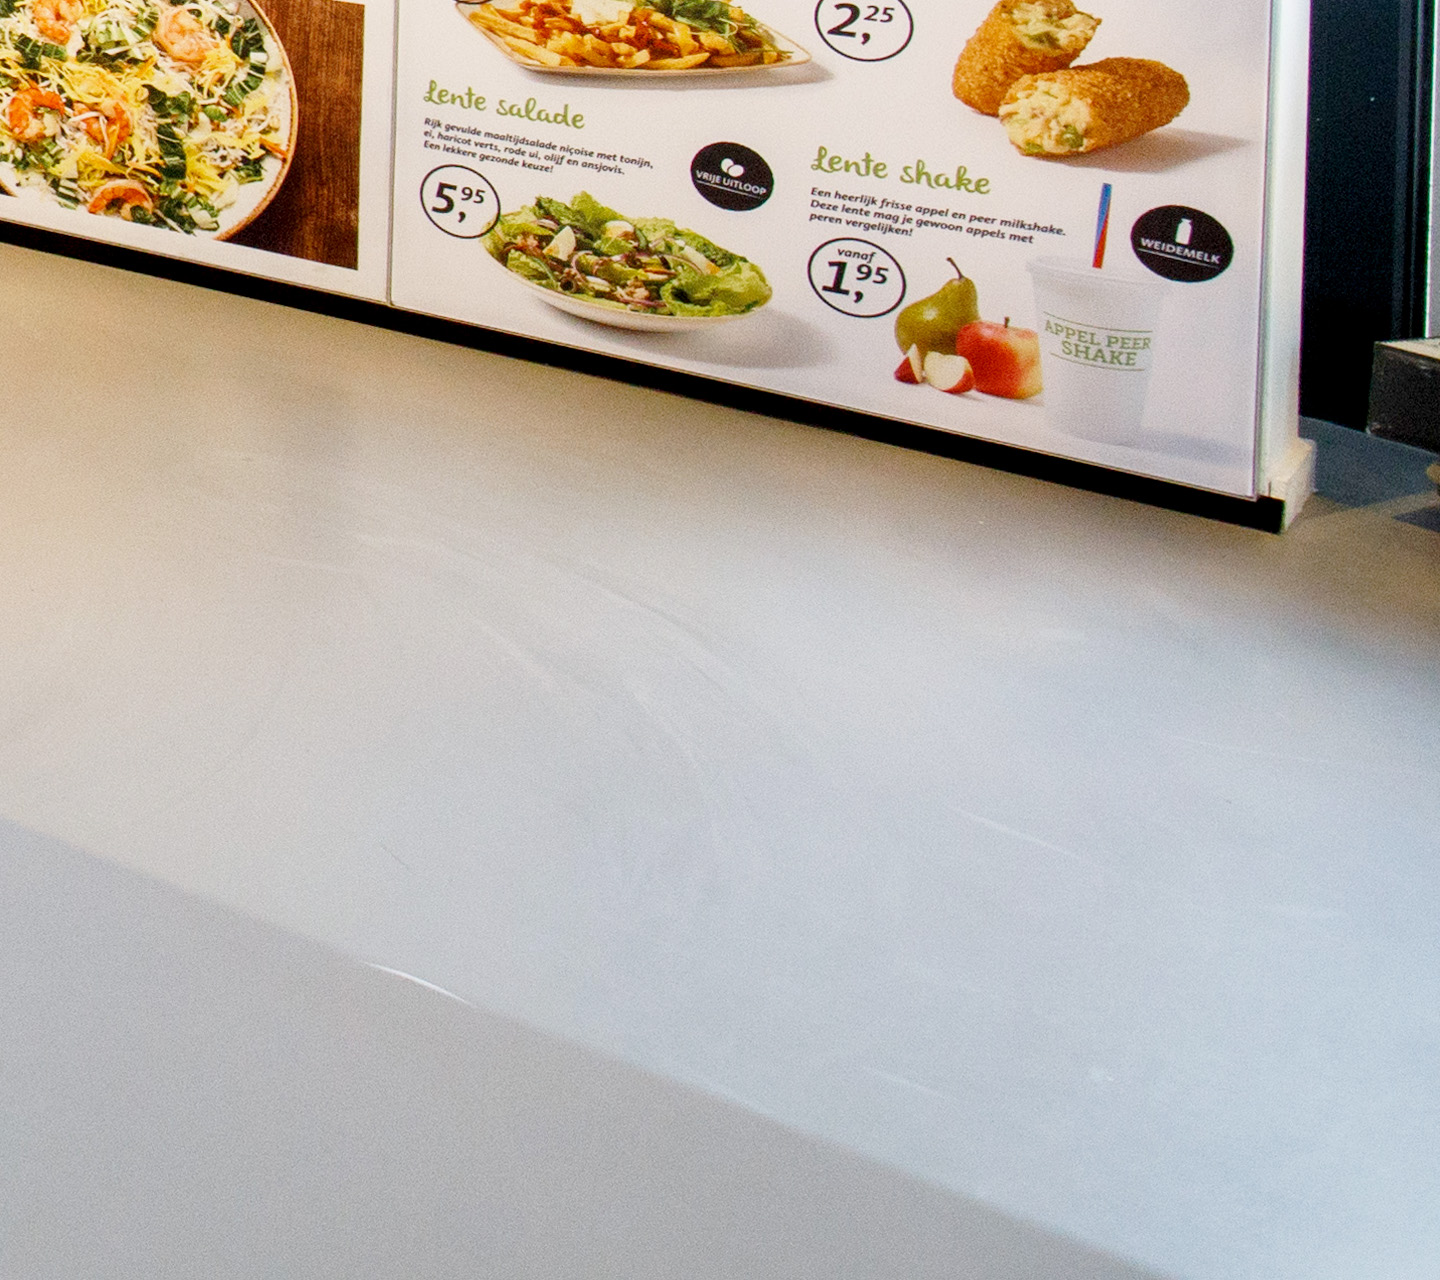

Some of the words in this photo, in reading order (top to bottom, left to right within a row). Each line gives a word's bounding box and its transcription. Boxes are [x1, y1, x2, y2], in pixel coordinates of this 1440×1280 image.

[424, 79, 487, 112] Lente
[496, 94, 586, 130] salade
[696, 170, 720, 182] VRIJE
[722, 176, 767, 197] UITLOOP
[810, 146, 889, 181] Lente
[900, 161, 992, 195] shake
[837, 246, 877, 263] vanaf
[1140, 237, 1221, 264] WEIDEMELK
[1045, 319, 1098, 348] APPEL
[1106, 333, 1152, 350] PEER
[1062, 341, 1137, 368] SHAKE
